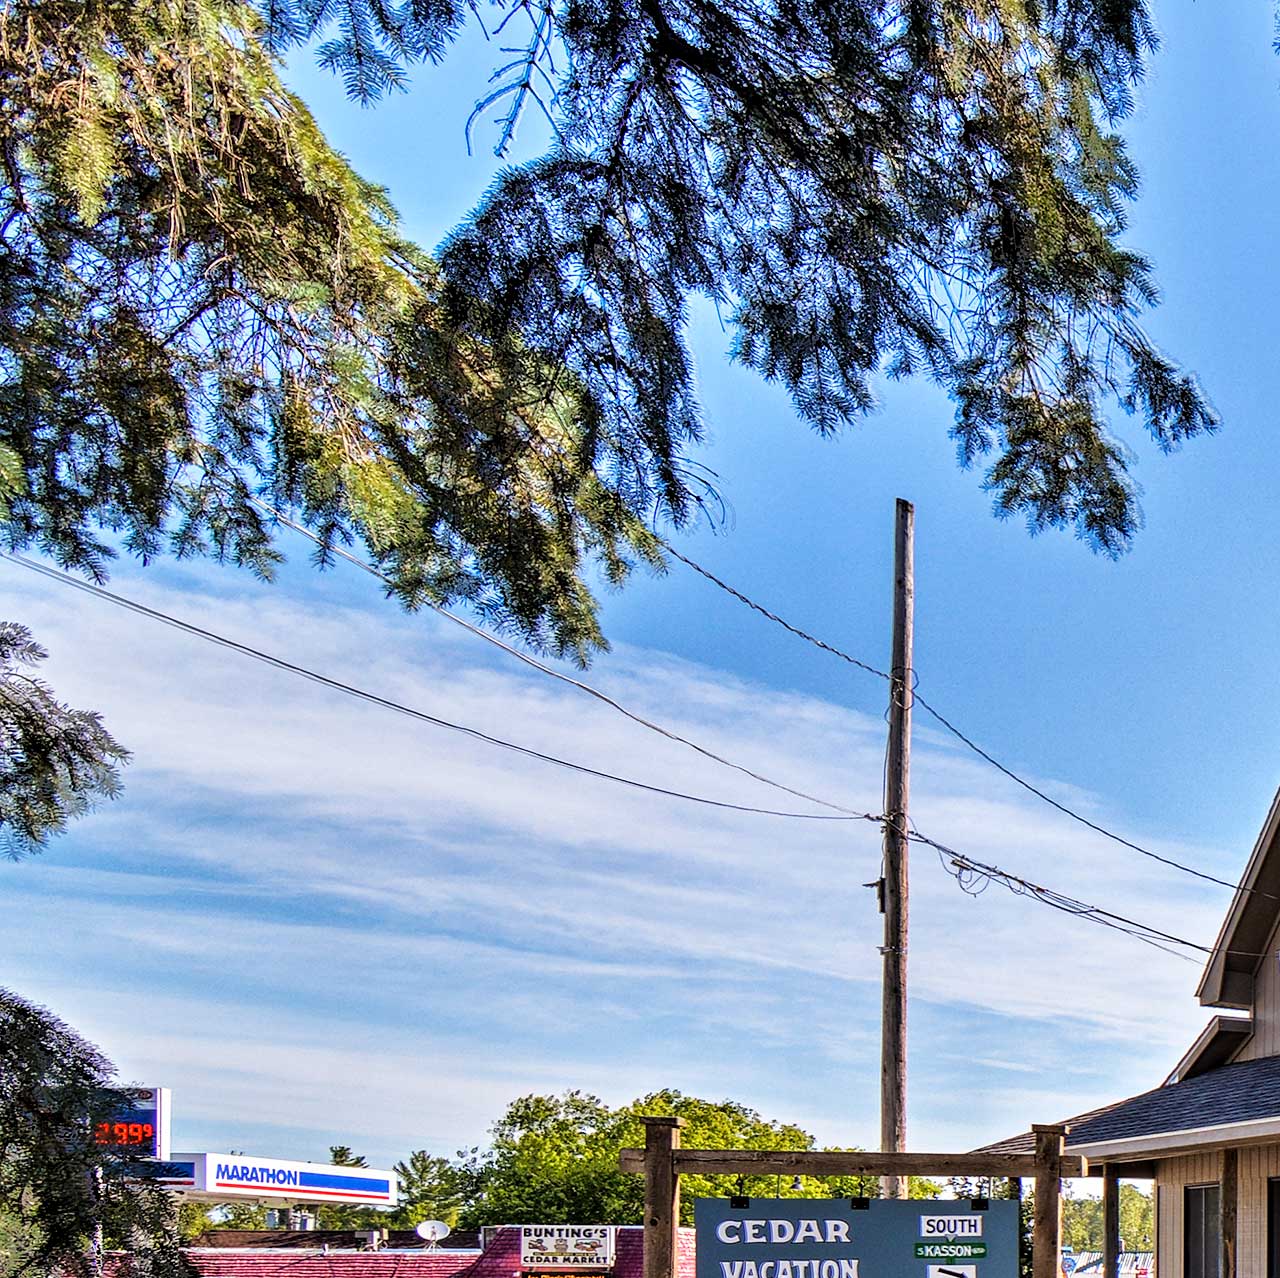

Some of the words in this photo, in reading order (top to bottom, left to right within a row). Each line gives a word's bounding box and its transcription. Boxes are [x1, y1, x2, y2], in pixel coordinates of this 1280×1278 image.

[216, 1163, 297, 1185] MARATHON
[523, 1228, 607, 1238] BUNTING'S
[716, 1219, 851, 1244] CEDAR
[926, 1219, 977, 1234] SOUTH
[924, 1245, 972, 1257] KASSON
[562, 1256, 607, 1264] MARKET
